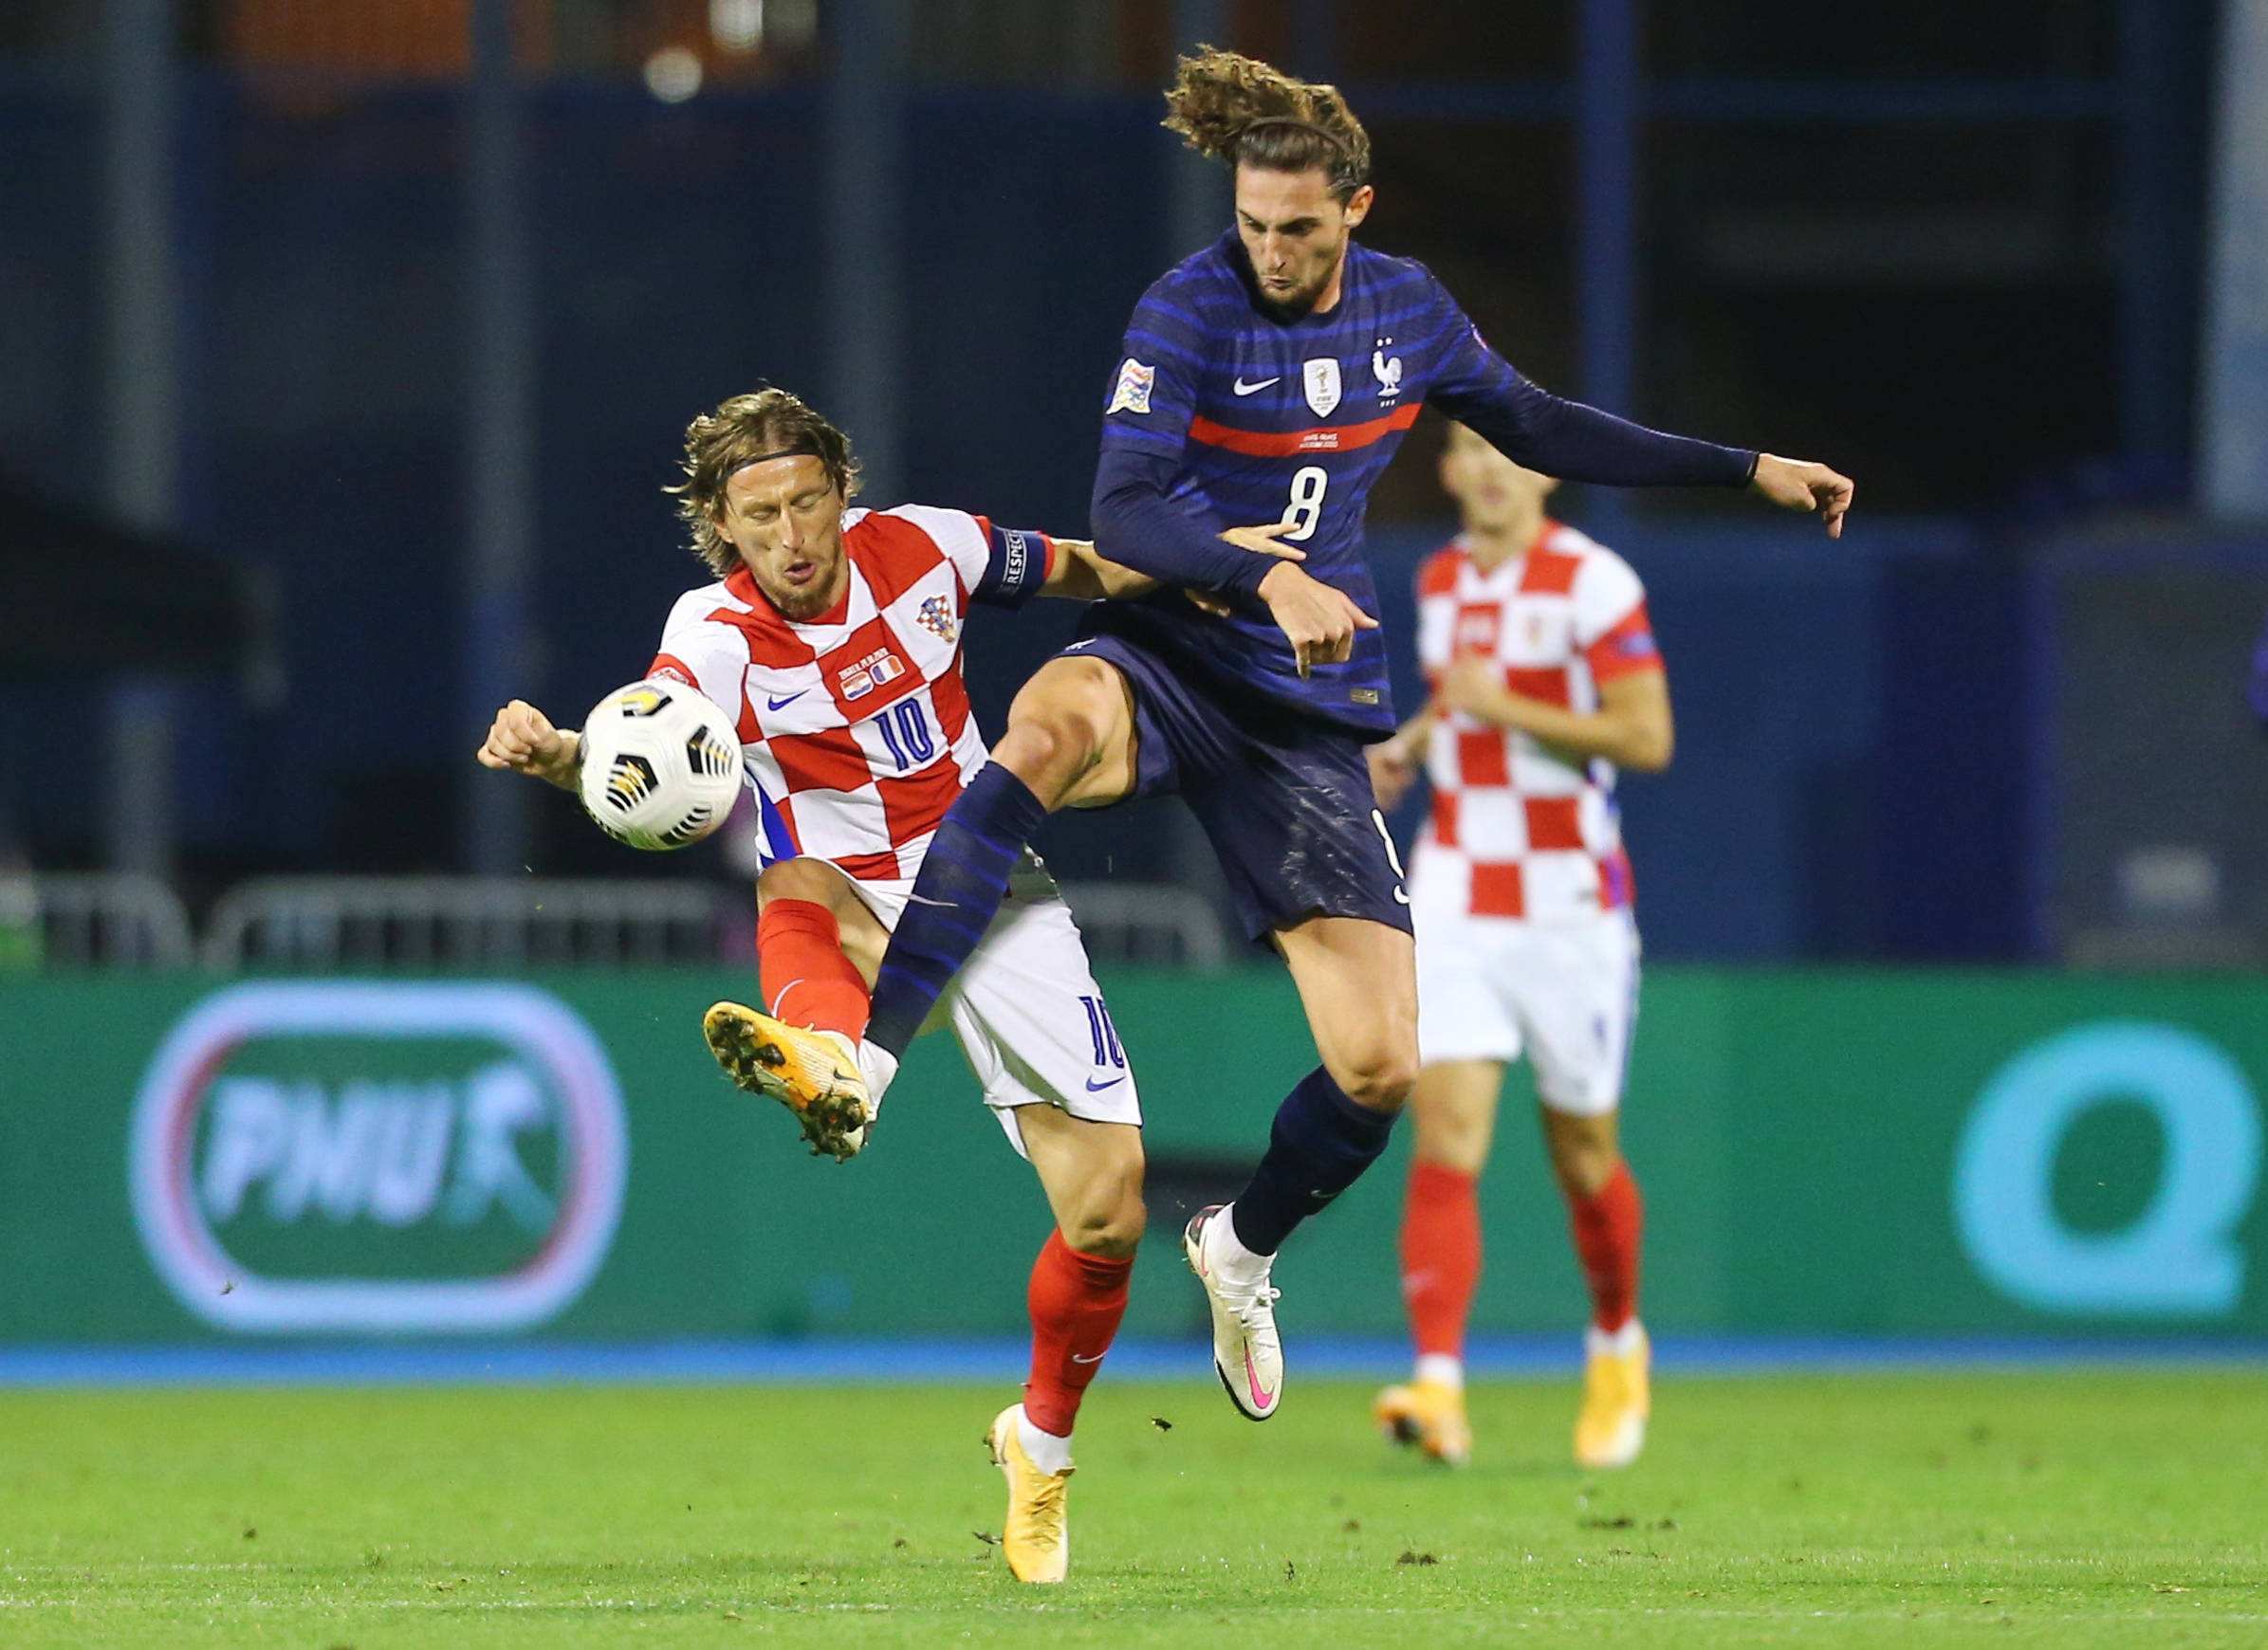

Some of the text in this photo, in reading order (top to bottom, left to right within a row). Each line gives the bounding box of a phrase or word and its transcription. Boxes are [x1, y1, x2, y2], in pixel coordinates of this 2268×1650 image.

[1281, 466, 1328, 541] 8
[871, 697, 933, 772] 10
[202, 1077, 452, 1222] PMU
[1954, 1019, 2259, 1316] Q
